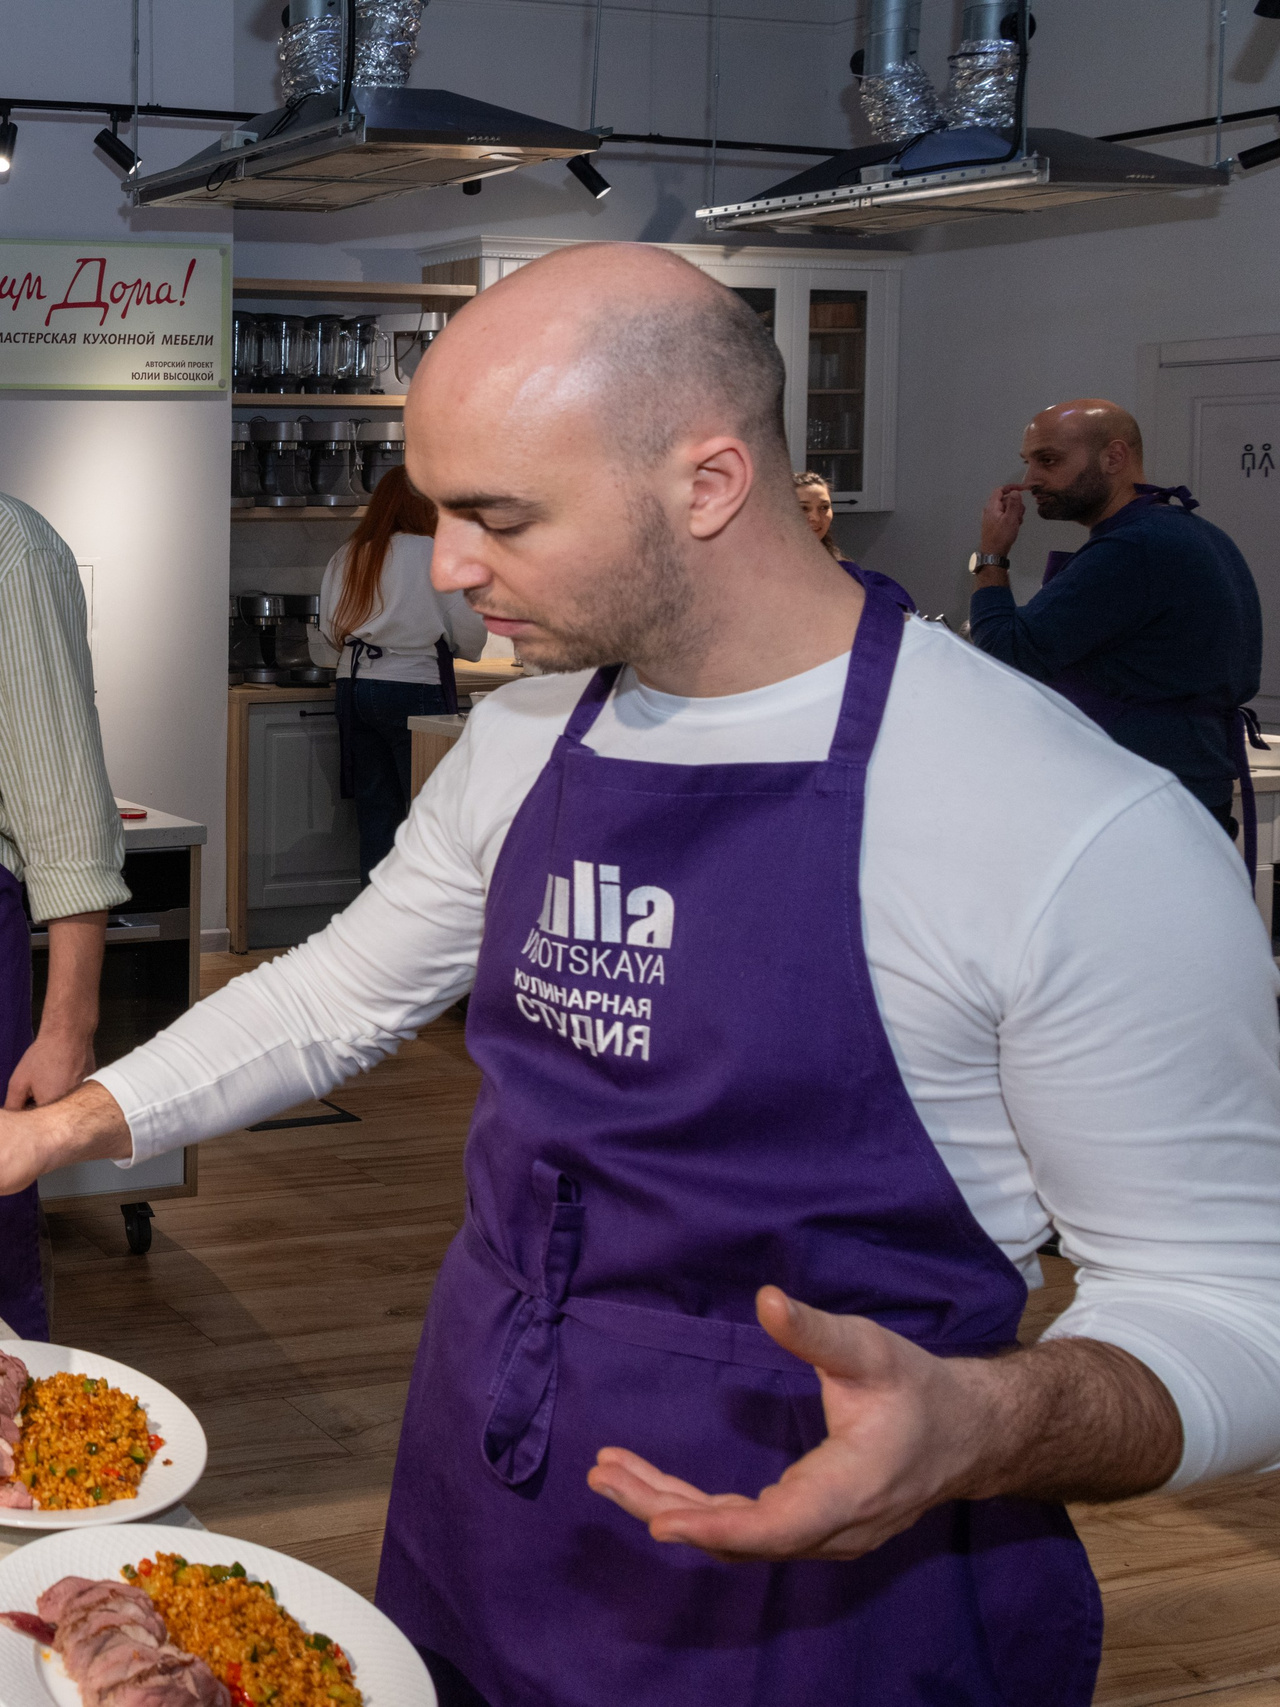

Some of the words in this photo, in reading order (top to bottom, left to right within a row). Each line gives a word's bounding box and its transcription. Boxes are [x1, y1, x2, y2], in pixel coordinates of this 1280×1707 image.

[44, 258, 197, 327] Дома!
[82, 330, 156, 346] КУХОННОЙ
[161, 334, 215, 346] МЕБЕЛИ
[145, 360, 186, 368] АВТОРСКИЙ
[131, 371, 160, 380] ЮЛИИ
[163, 371, 214, 382] ВЫСОЦКОЙ
[536, 860, 675, 949] ulia
[514, 967, 652, 1020] КУЛИНАРНАЯ
[516, 993, 651, 1062] СТУДИЯ
